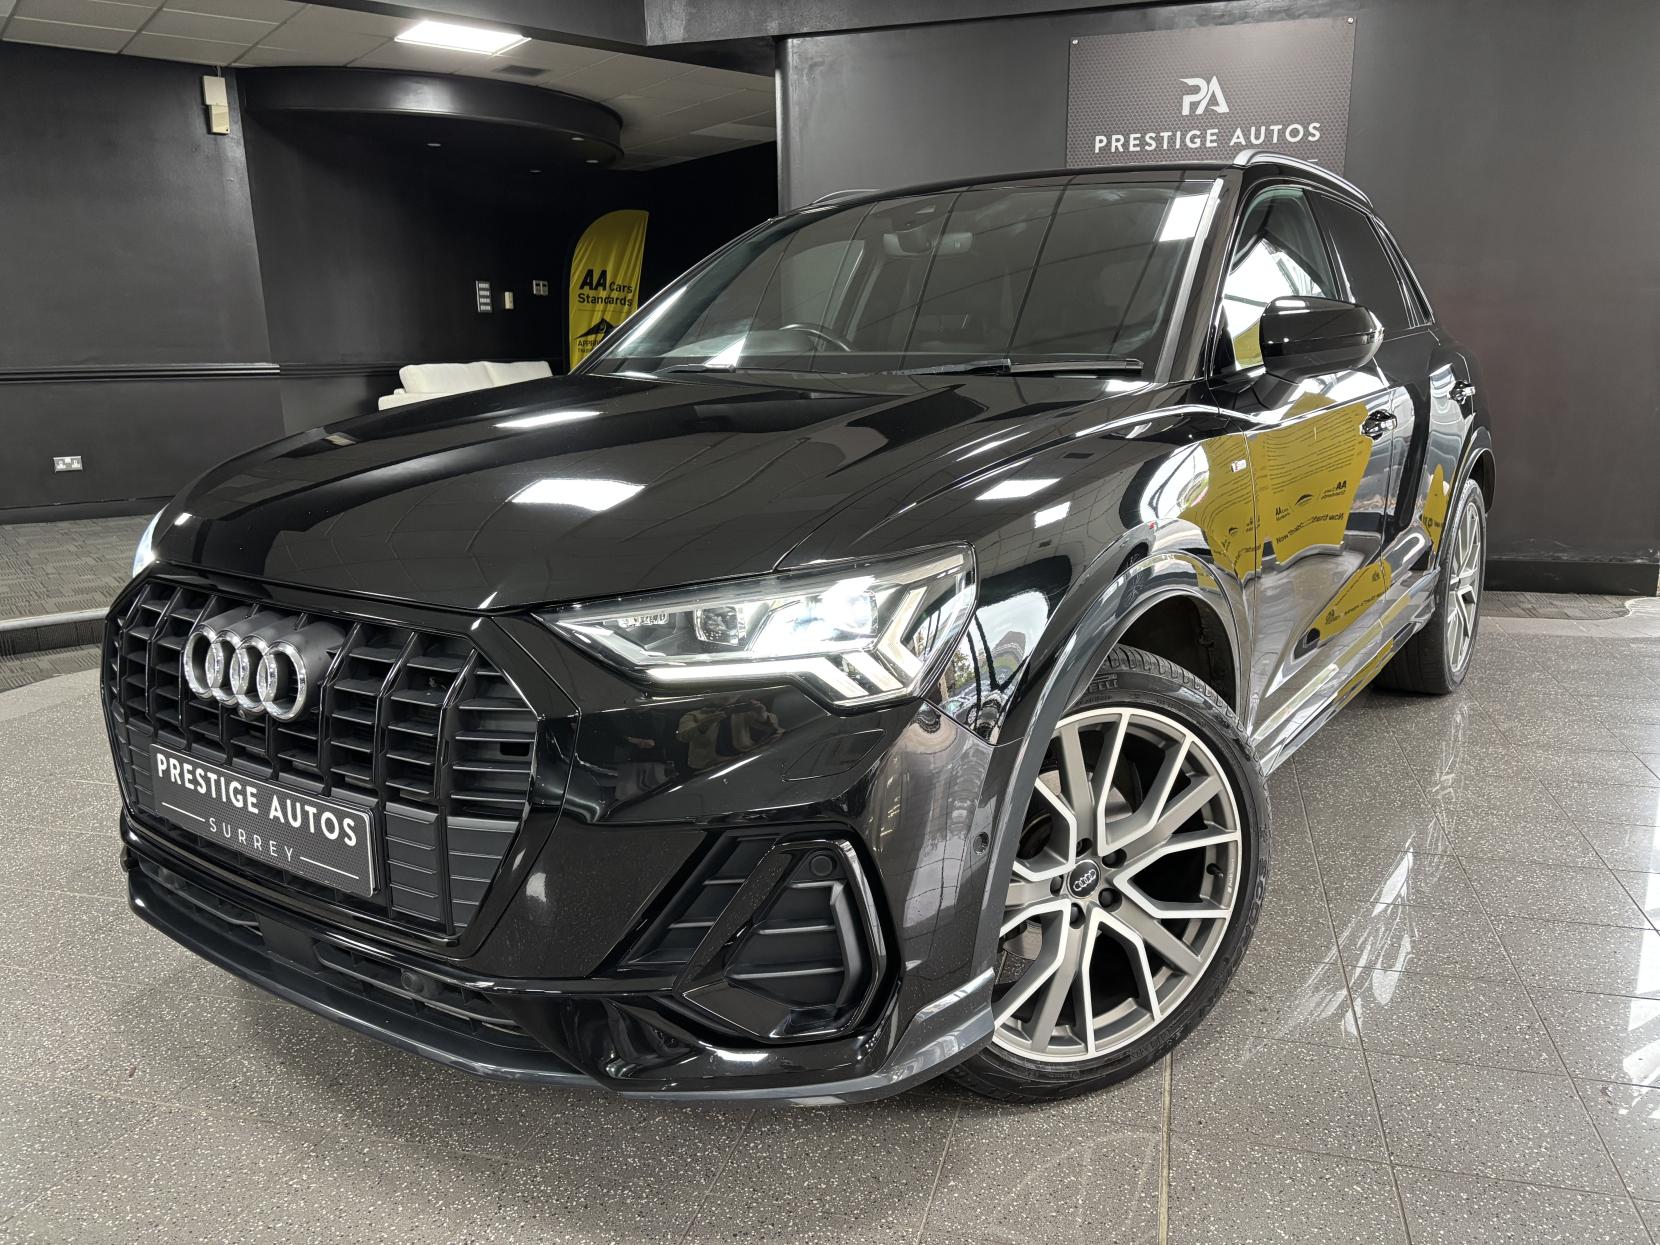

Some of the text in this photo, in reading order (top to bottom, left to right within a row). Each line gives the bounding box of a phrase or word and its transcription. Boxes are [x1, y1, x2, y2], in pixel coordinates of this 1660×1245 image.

[1179, 75, 1230, 115] PA
[1094, 122, 1321, 153] PRESTIGE AUTOS
[579, 269, 632, 293] AA Cars
[577, 293, 632, 306] Standards
[156, 753, 357, 847] PRESTIGE AUTOS
[209, 817, 293, 862] SURREY
